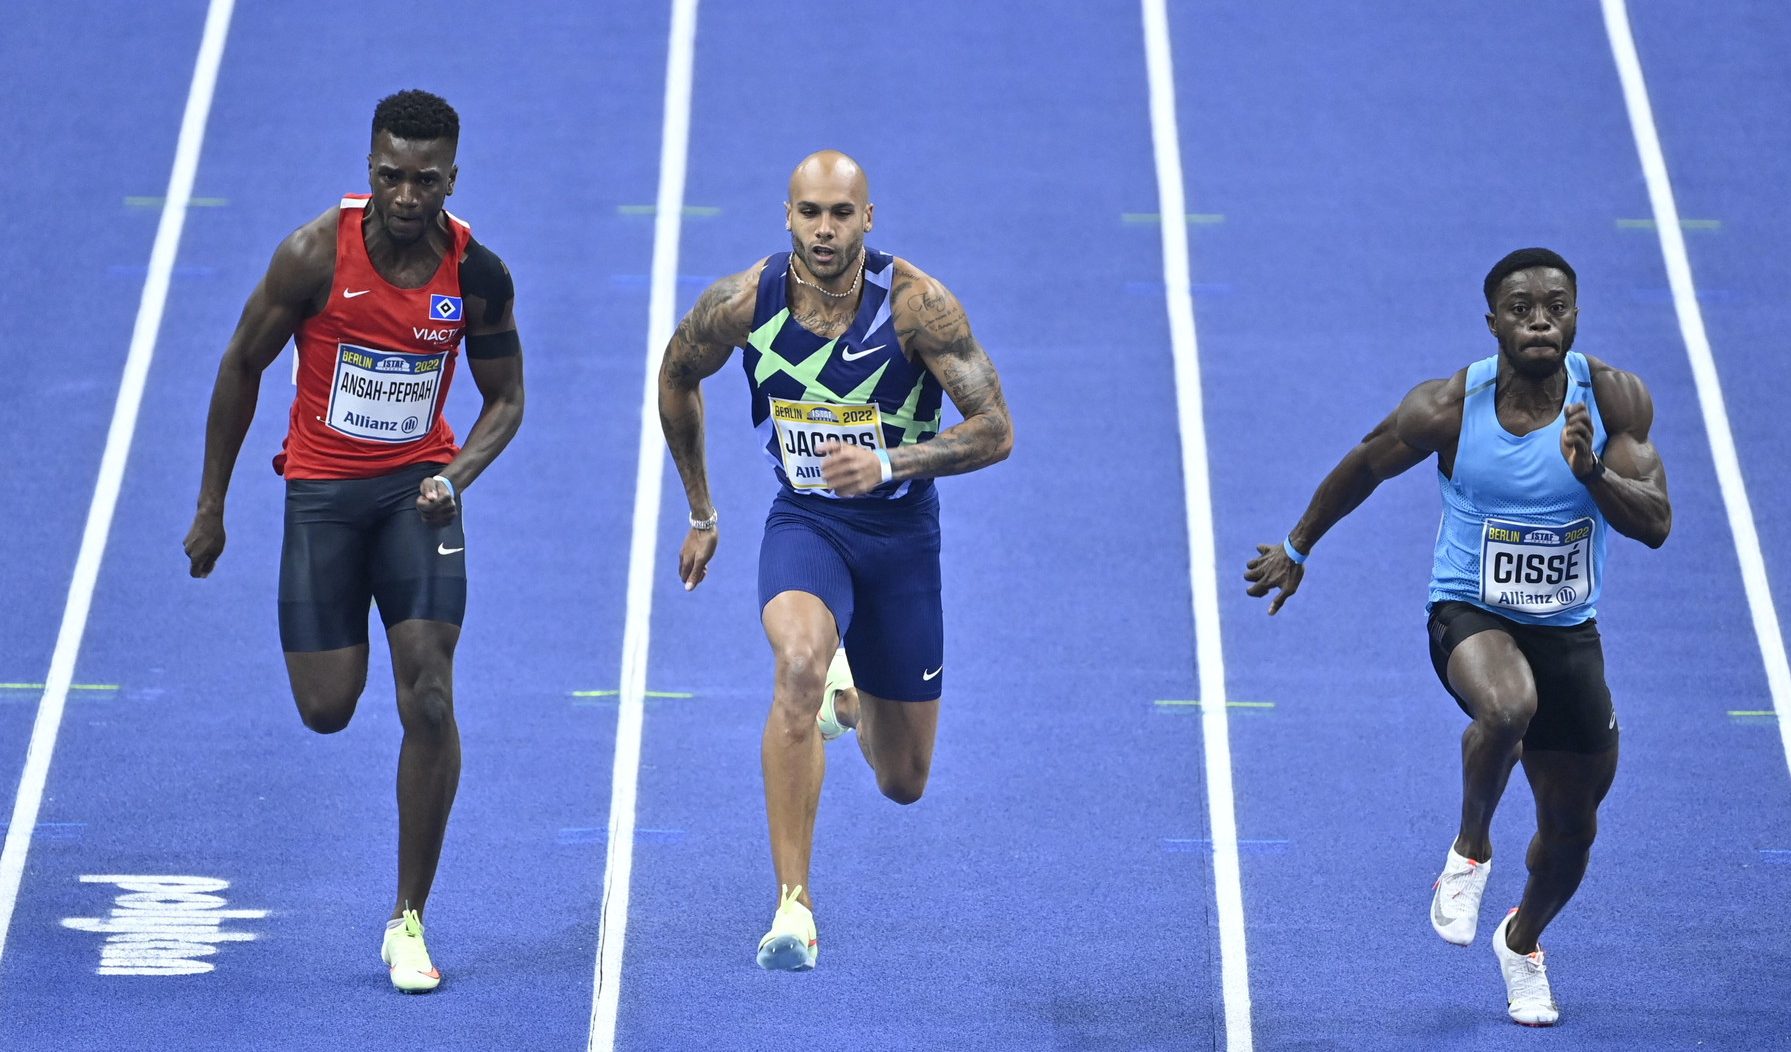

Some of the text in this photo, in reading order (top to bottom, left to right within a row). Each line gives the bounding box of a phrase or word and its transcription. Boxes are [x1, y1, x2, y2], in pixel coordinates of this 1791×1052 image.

[342, 350, 440, 373] BERLIN ISTAF 2022
[340, 371, 434, 403] ANSAH-PEPRAH
[343, 411, 399, 432] Allianz
[775, 405, 803, 420] BERLIN
[842, 410, 873, 423] 2022
[1488, 526, 1590, 544] BERLIN ISTAF 2022
[1493, 543, 1580, 585] CISSÉ
[1498, 591, 1553, 605] Allianz
[60, 874, 272, 976] polytan
